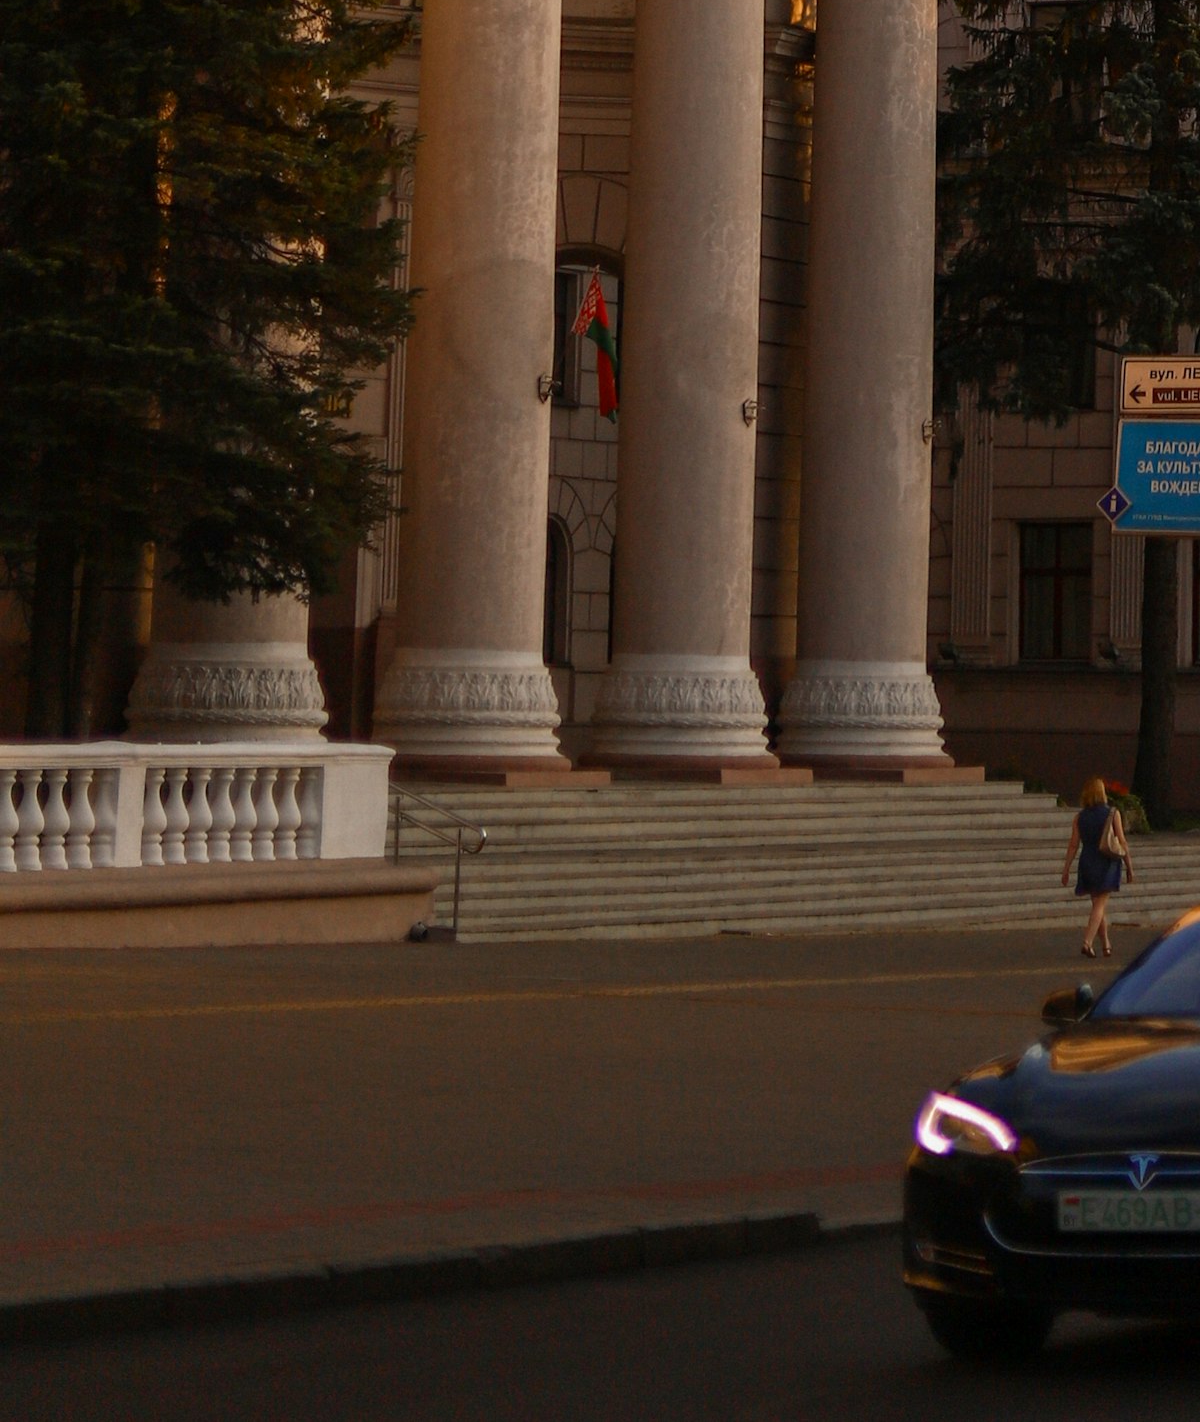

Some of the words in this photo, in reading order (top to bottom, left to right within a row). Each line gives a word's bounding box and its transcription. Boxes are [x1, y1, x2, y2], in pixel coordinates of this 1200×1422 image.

[1149, 369, 1178, 382] вул.
[1156, 389, 1178, 401] vul.
[1136, 460, 1154, 473] ЗА
